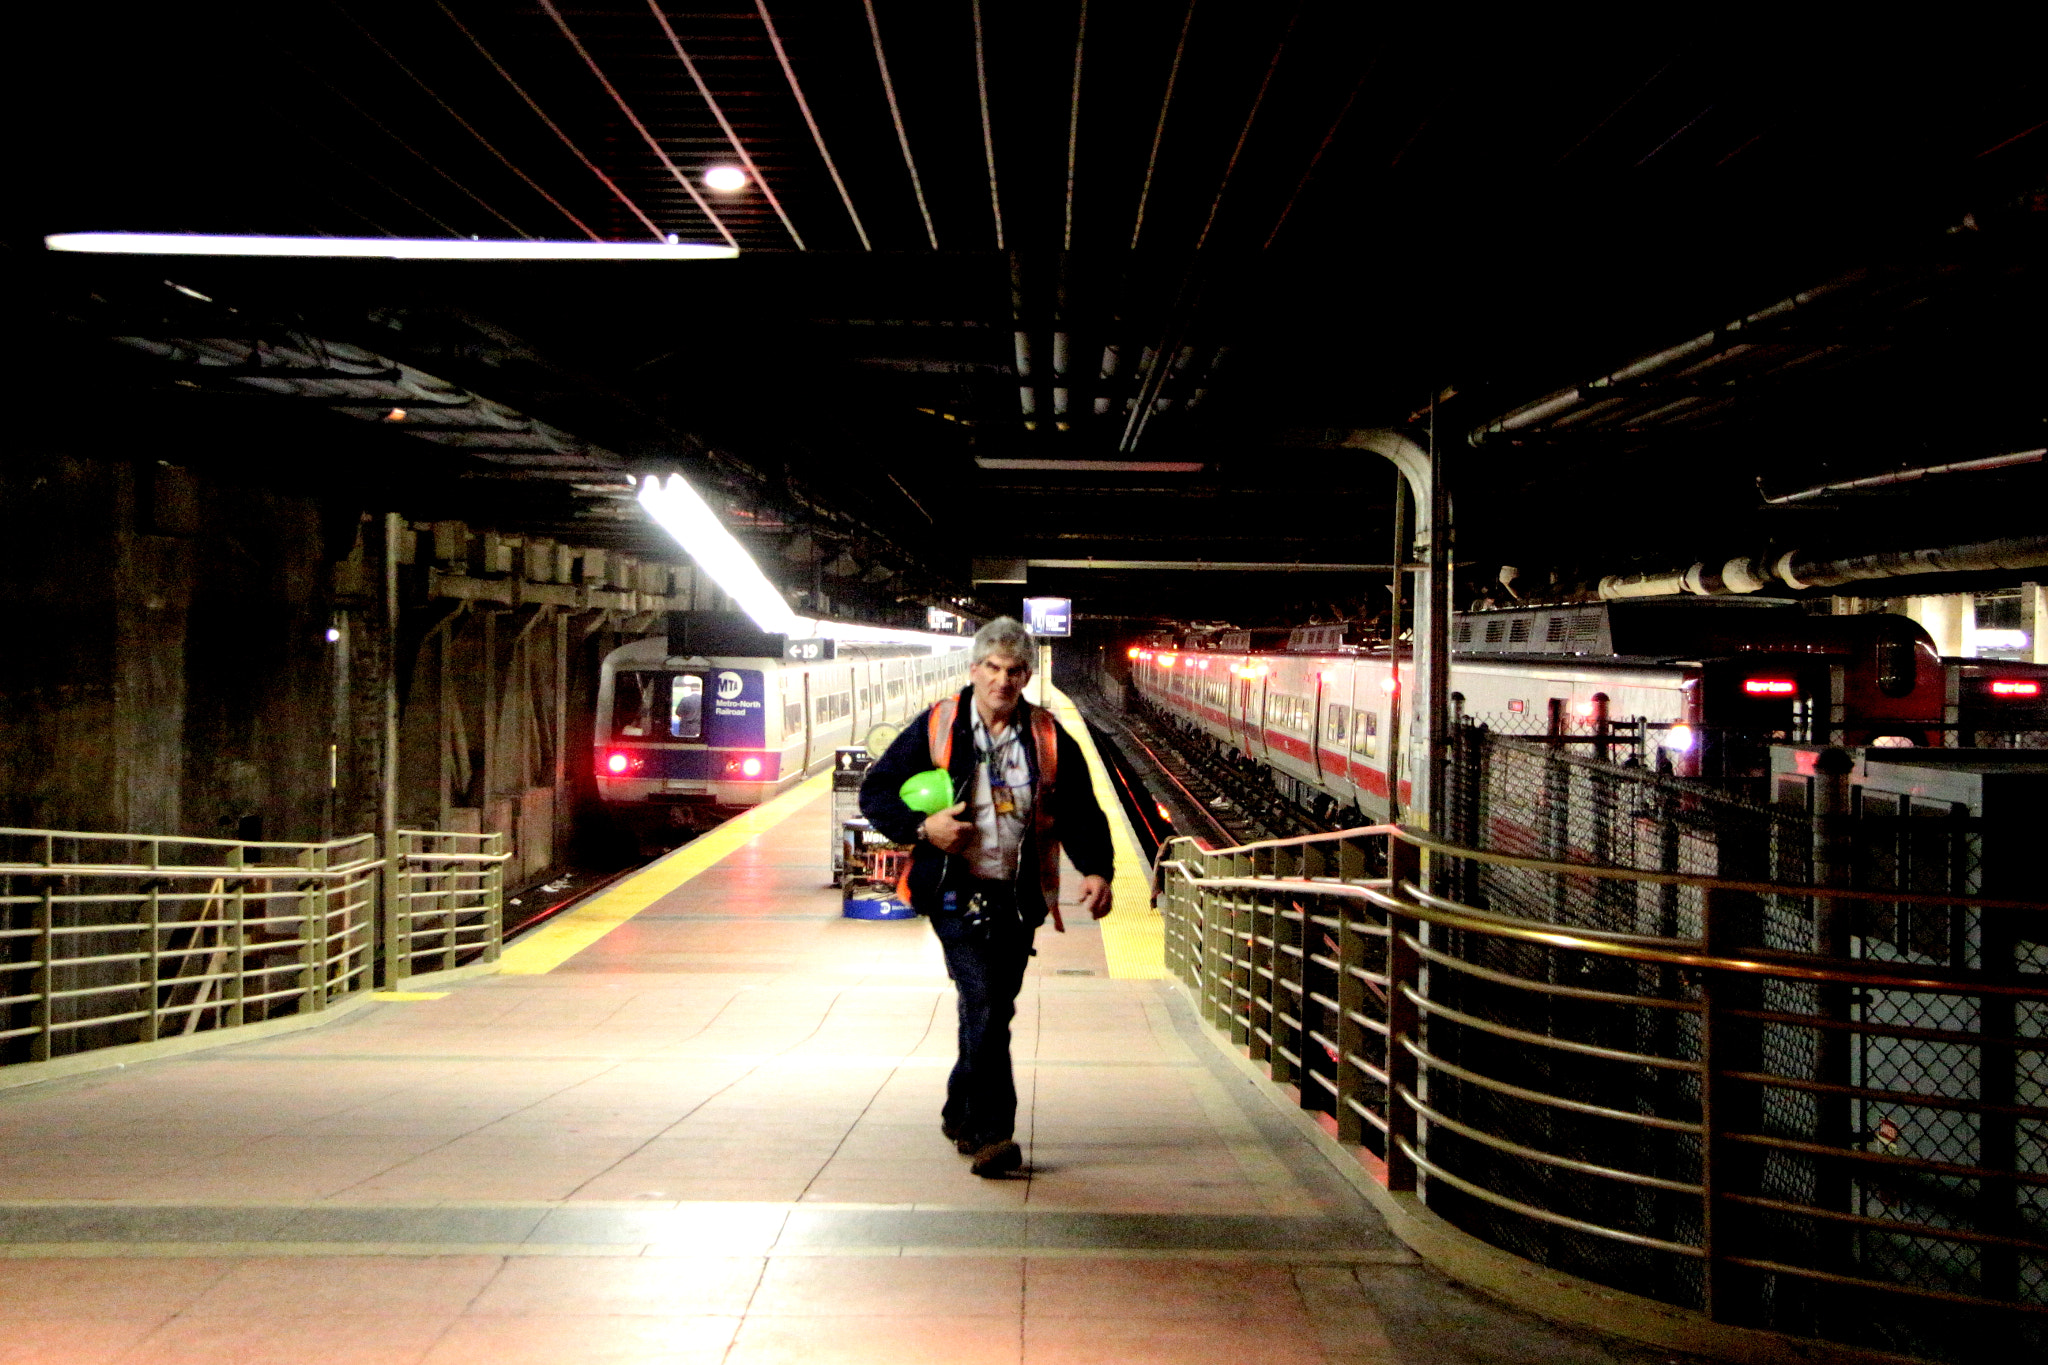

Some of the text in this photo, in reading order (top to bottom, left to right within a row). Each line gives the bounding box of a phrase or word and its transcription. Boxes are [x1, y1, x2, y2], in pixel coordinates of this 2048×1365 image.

[803, 644, 818, 658] 19
[719, 679, 738, 692] MTA
[716, 700, 761, 708] Metro-North
[716, 708, 746, 716] Railroad
